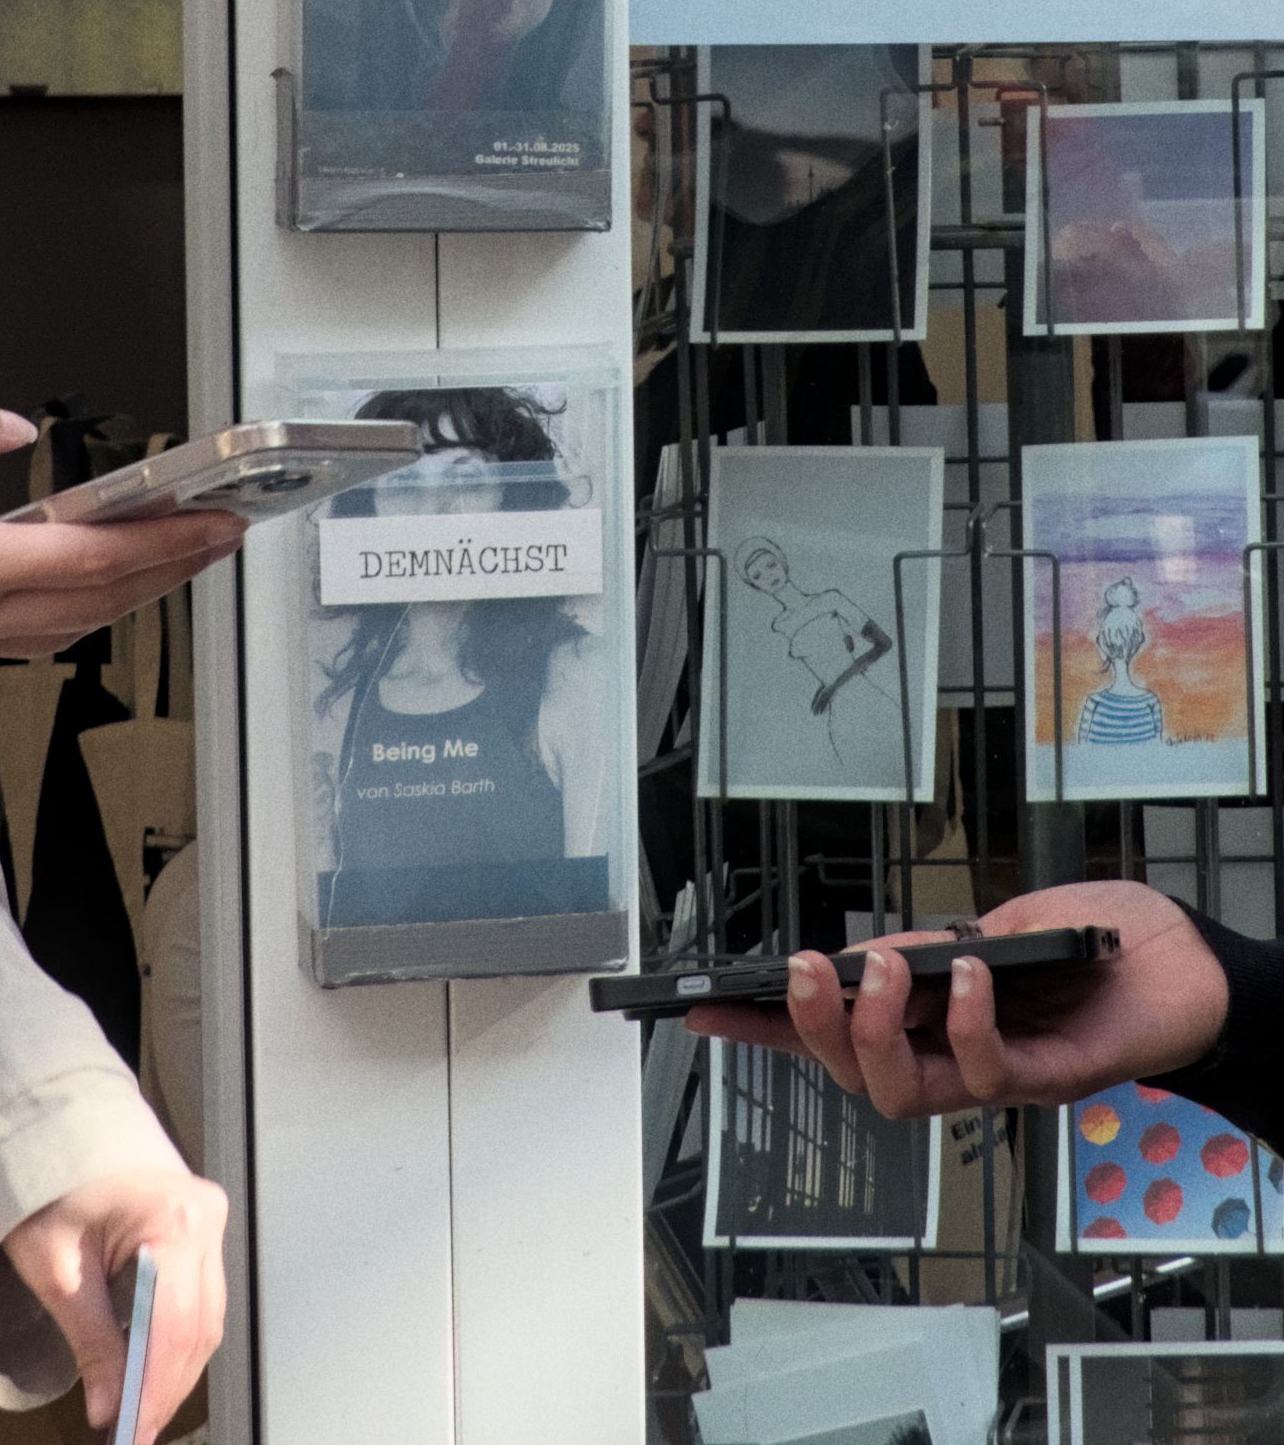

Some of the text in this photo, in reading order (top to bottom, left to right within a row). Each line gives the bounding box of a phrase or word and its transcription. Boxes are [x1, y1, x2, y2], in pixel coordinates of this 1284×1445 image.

[474, 154, 519, 165] Galerie
[359, 538, 568, 579] DEMNÄCHST
[372, 739, 479, 764] Being Me
[393, 781, 446, 797] Saskia
[451, 778, 495, 795] Barth
